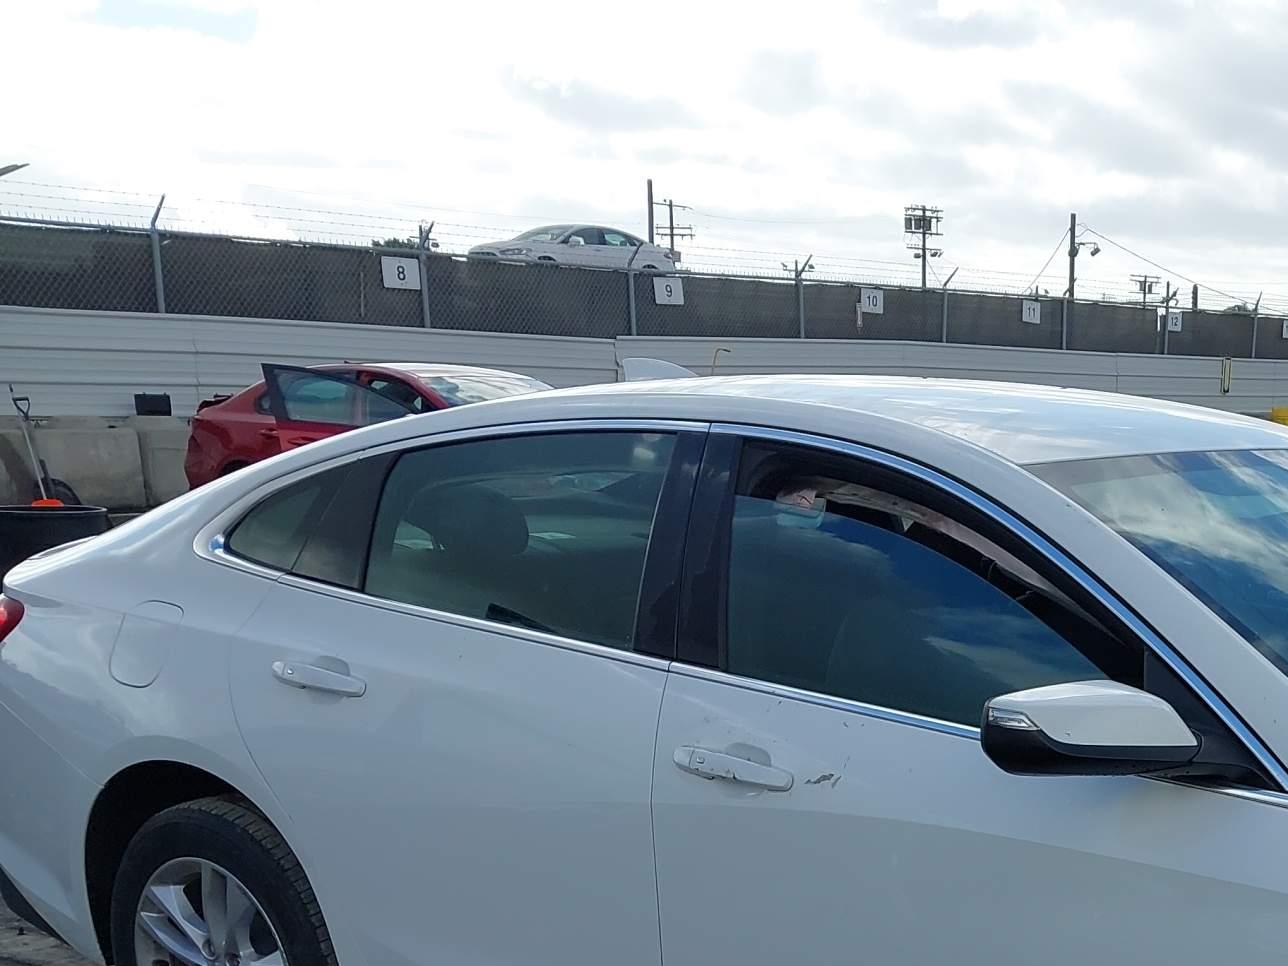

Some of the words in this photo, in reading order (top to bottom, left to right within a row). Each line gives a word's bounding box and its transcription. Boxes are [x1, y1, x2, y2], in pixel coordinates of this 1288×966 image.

[396, 265, 406, 281] 8
[664, 284, 673, 298] 9
[866, 295, 878, 307] 10
[1027, 305, 1036, 319] 11
[1170, 316, 1179, 327] 12
